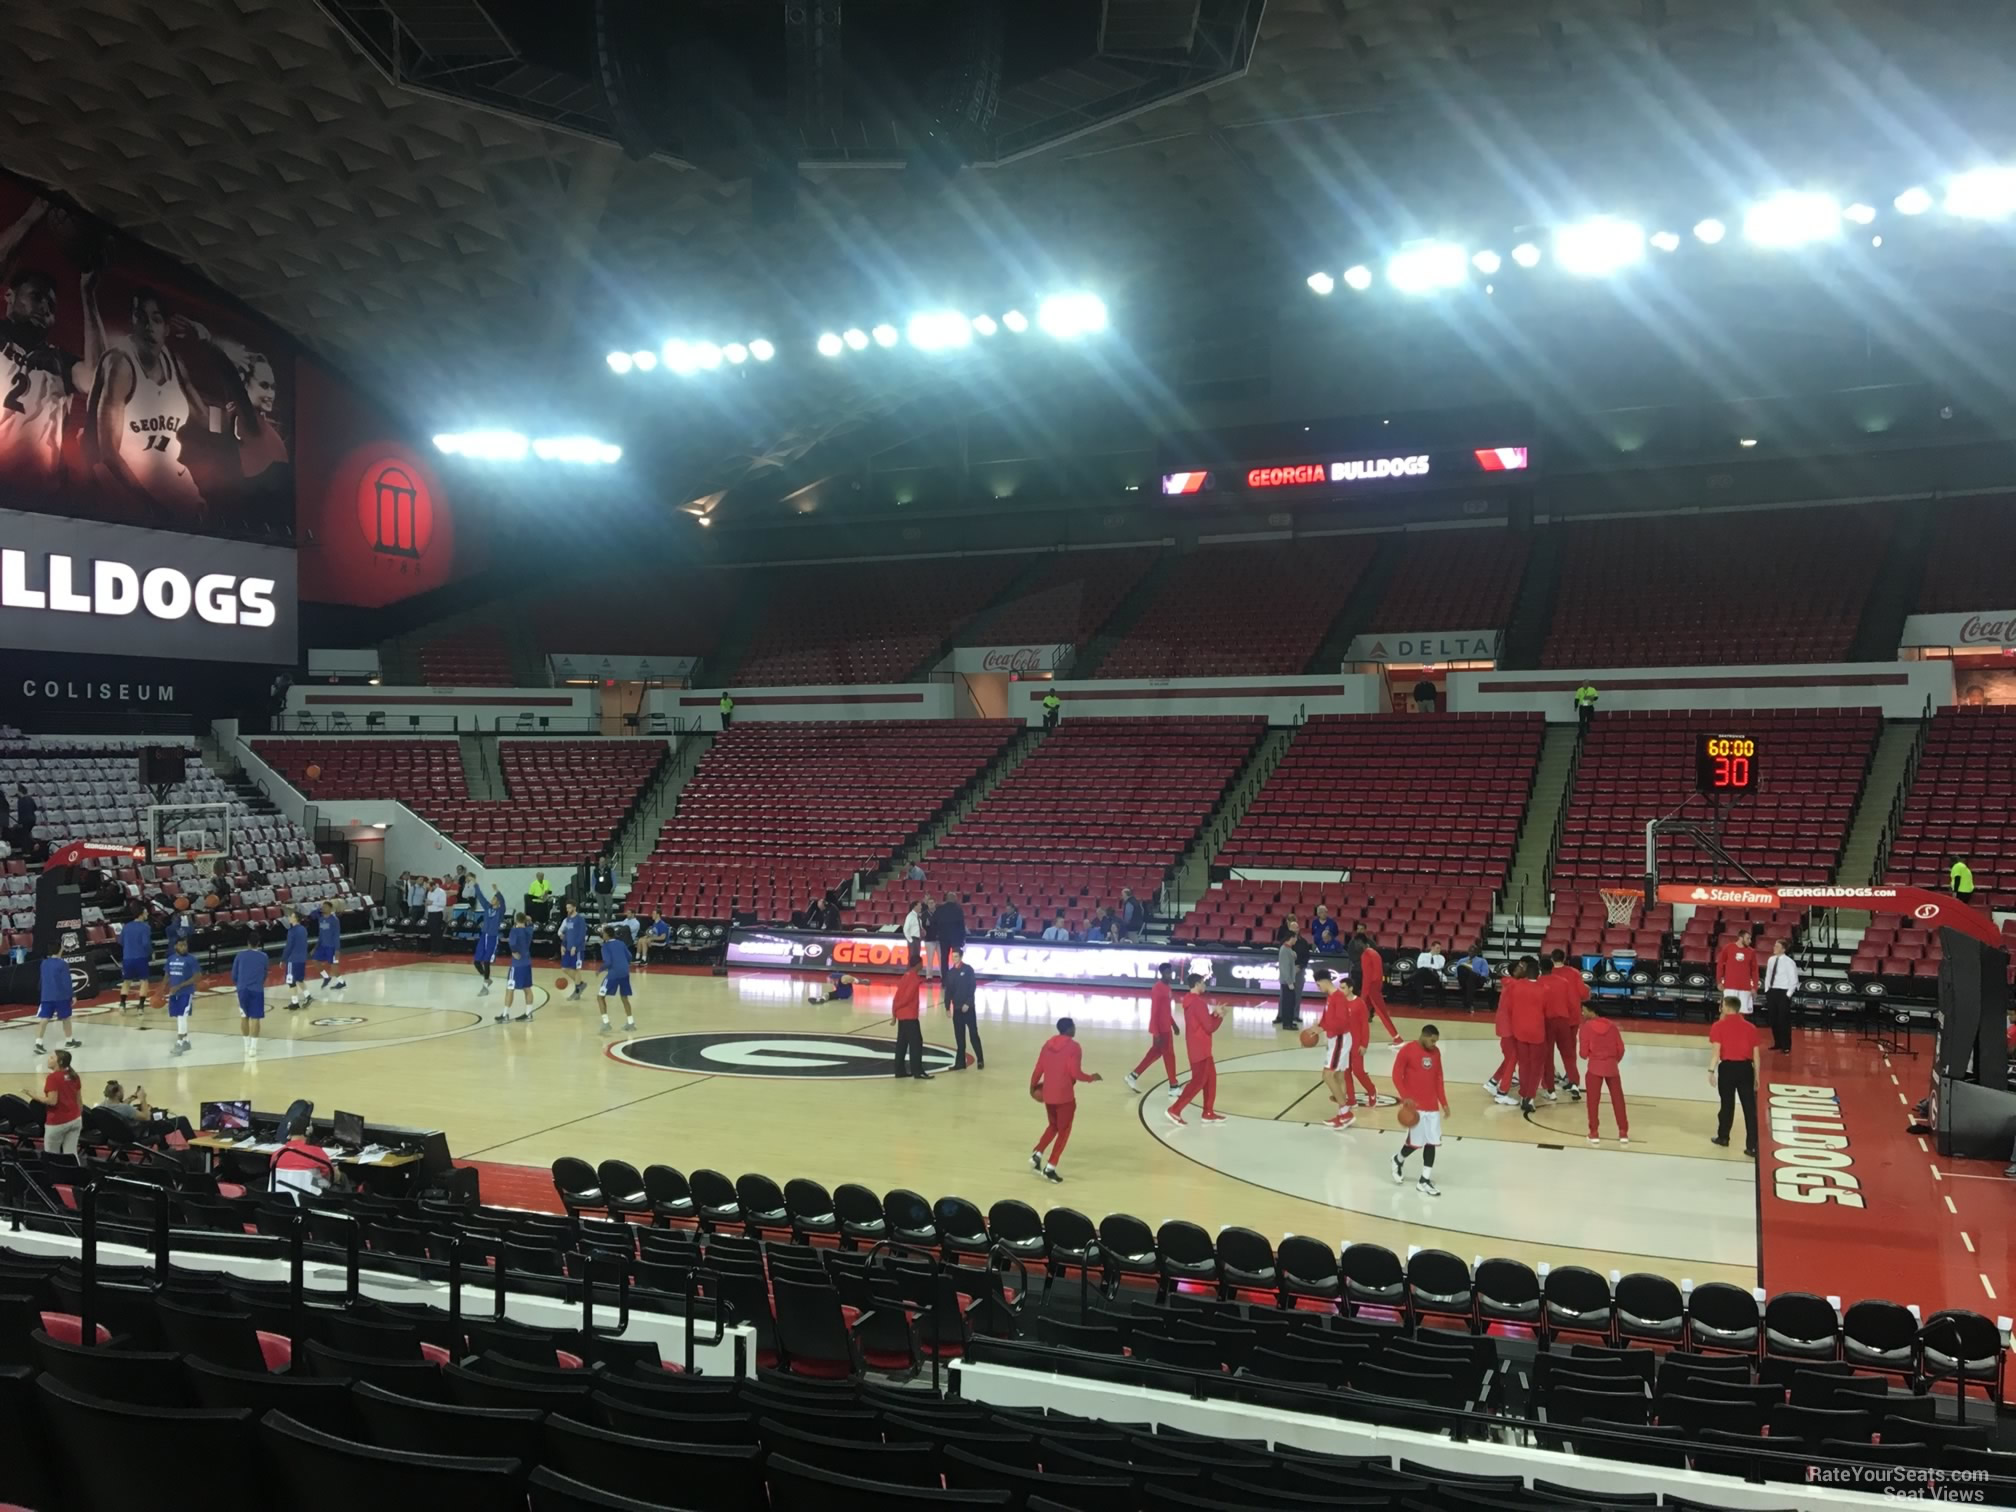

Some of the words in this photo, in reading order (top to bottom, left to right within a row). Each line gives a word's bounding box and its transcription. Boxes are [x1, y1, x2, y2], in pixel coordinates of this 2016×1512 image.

[129, 415, 182, 433] GEORGI
[1248, 464, 1325, 487] GEORGIA
[1331, 455, 1429, 481] BULLDOGS
[1, 548, 276, 627] LLDOGS
[1398, 638, 1489, 656] DELTA
[982, 648, 1041, 671] Coca-Cola
[23, 680, 174, 701] COLISEUM
[1709, 739, 1754, 756] 60:00
[1715, 758, 1748, 786] 30
[832, 941, 940, 967] GEOR
[1768, 1083, 1867, 1209] BULLDOGS
